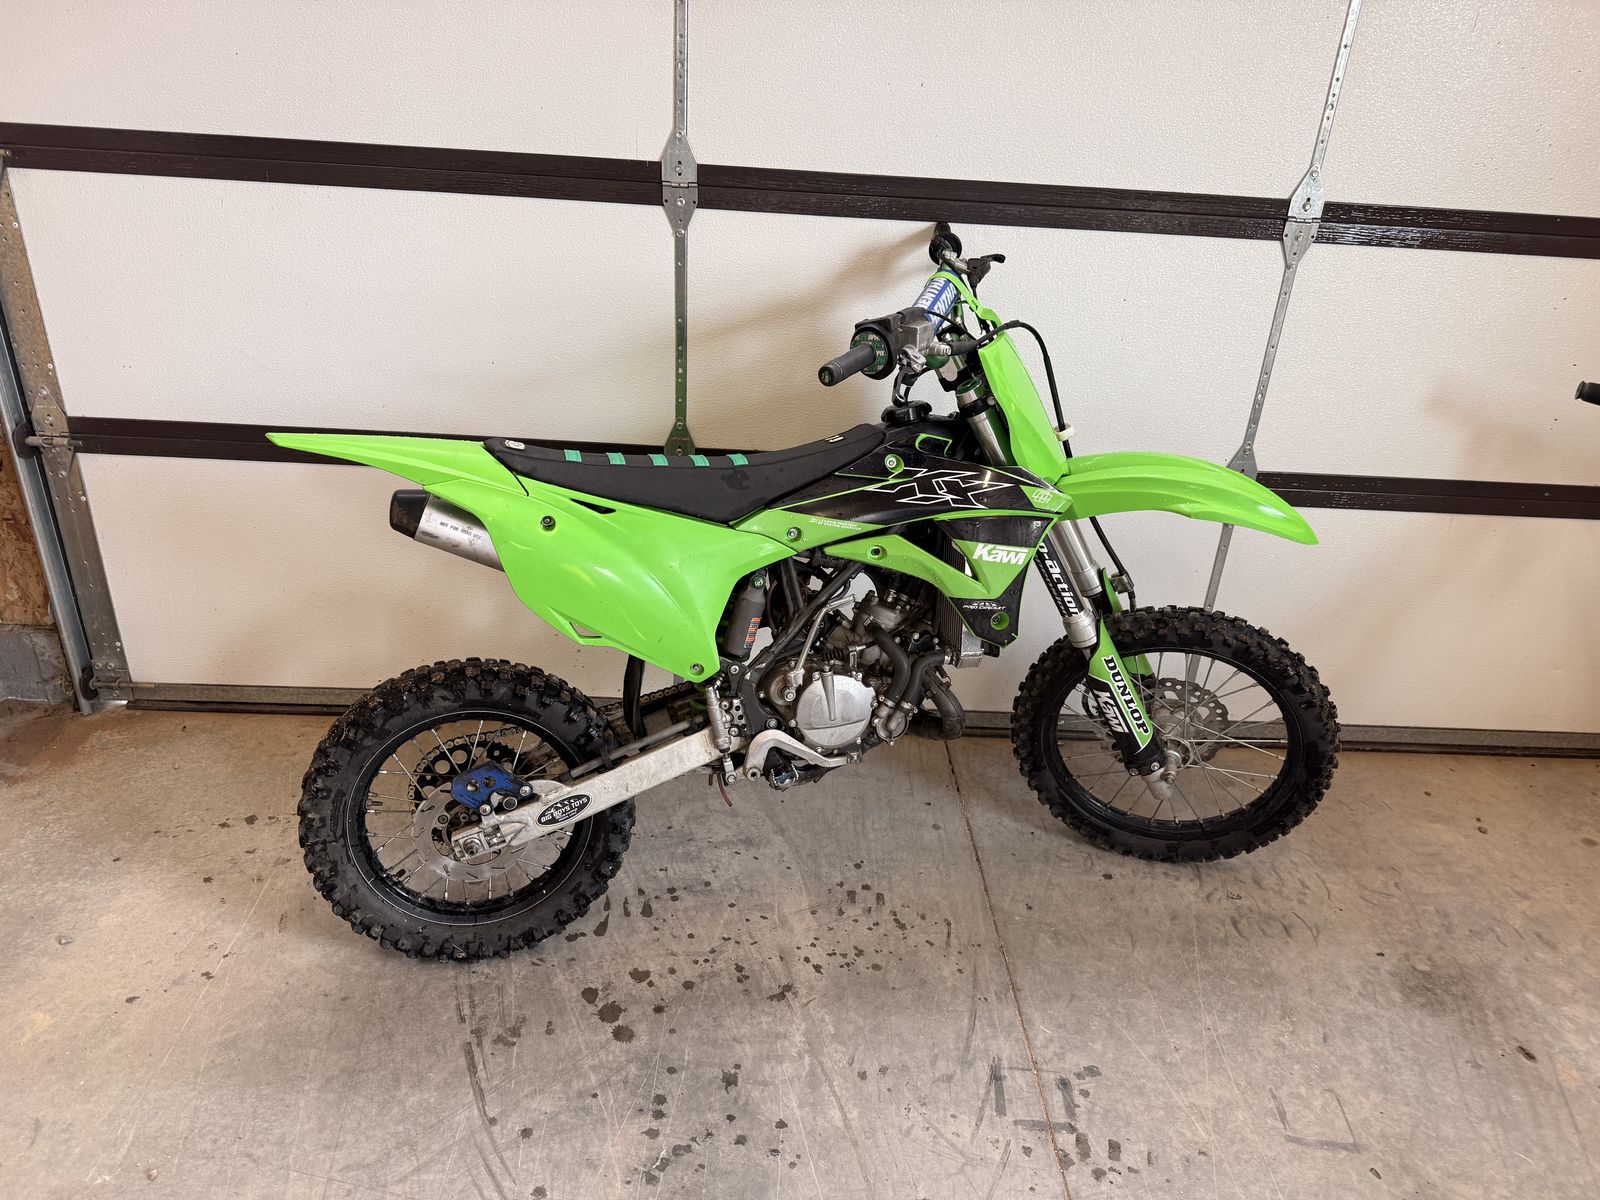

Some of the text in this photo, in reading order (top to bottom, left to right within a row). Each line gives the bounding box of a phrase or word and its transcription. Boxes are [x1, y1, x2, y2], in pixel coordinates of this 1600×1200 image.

[1102, 655, 1150, 735] DUNLOP
[541, 813, 552, 823] BIG
[553, 805, 571, 817] BOYS
[571, 797, 588, 809] TOYS
